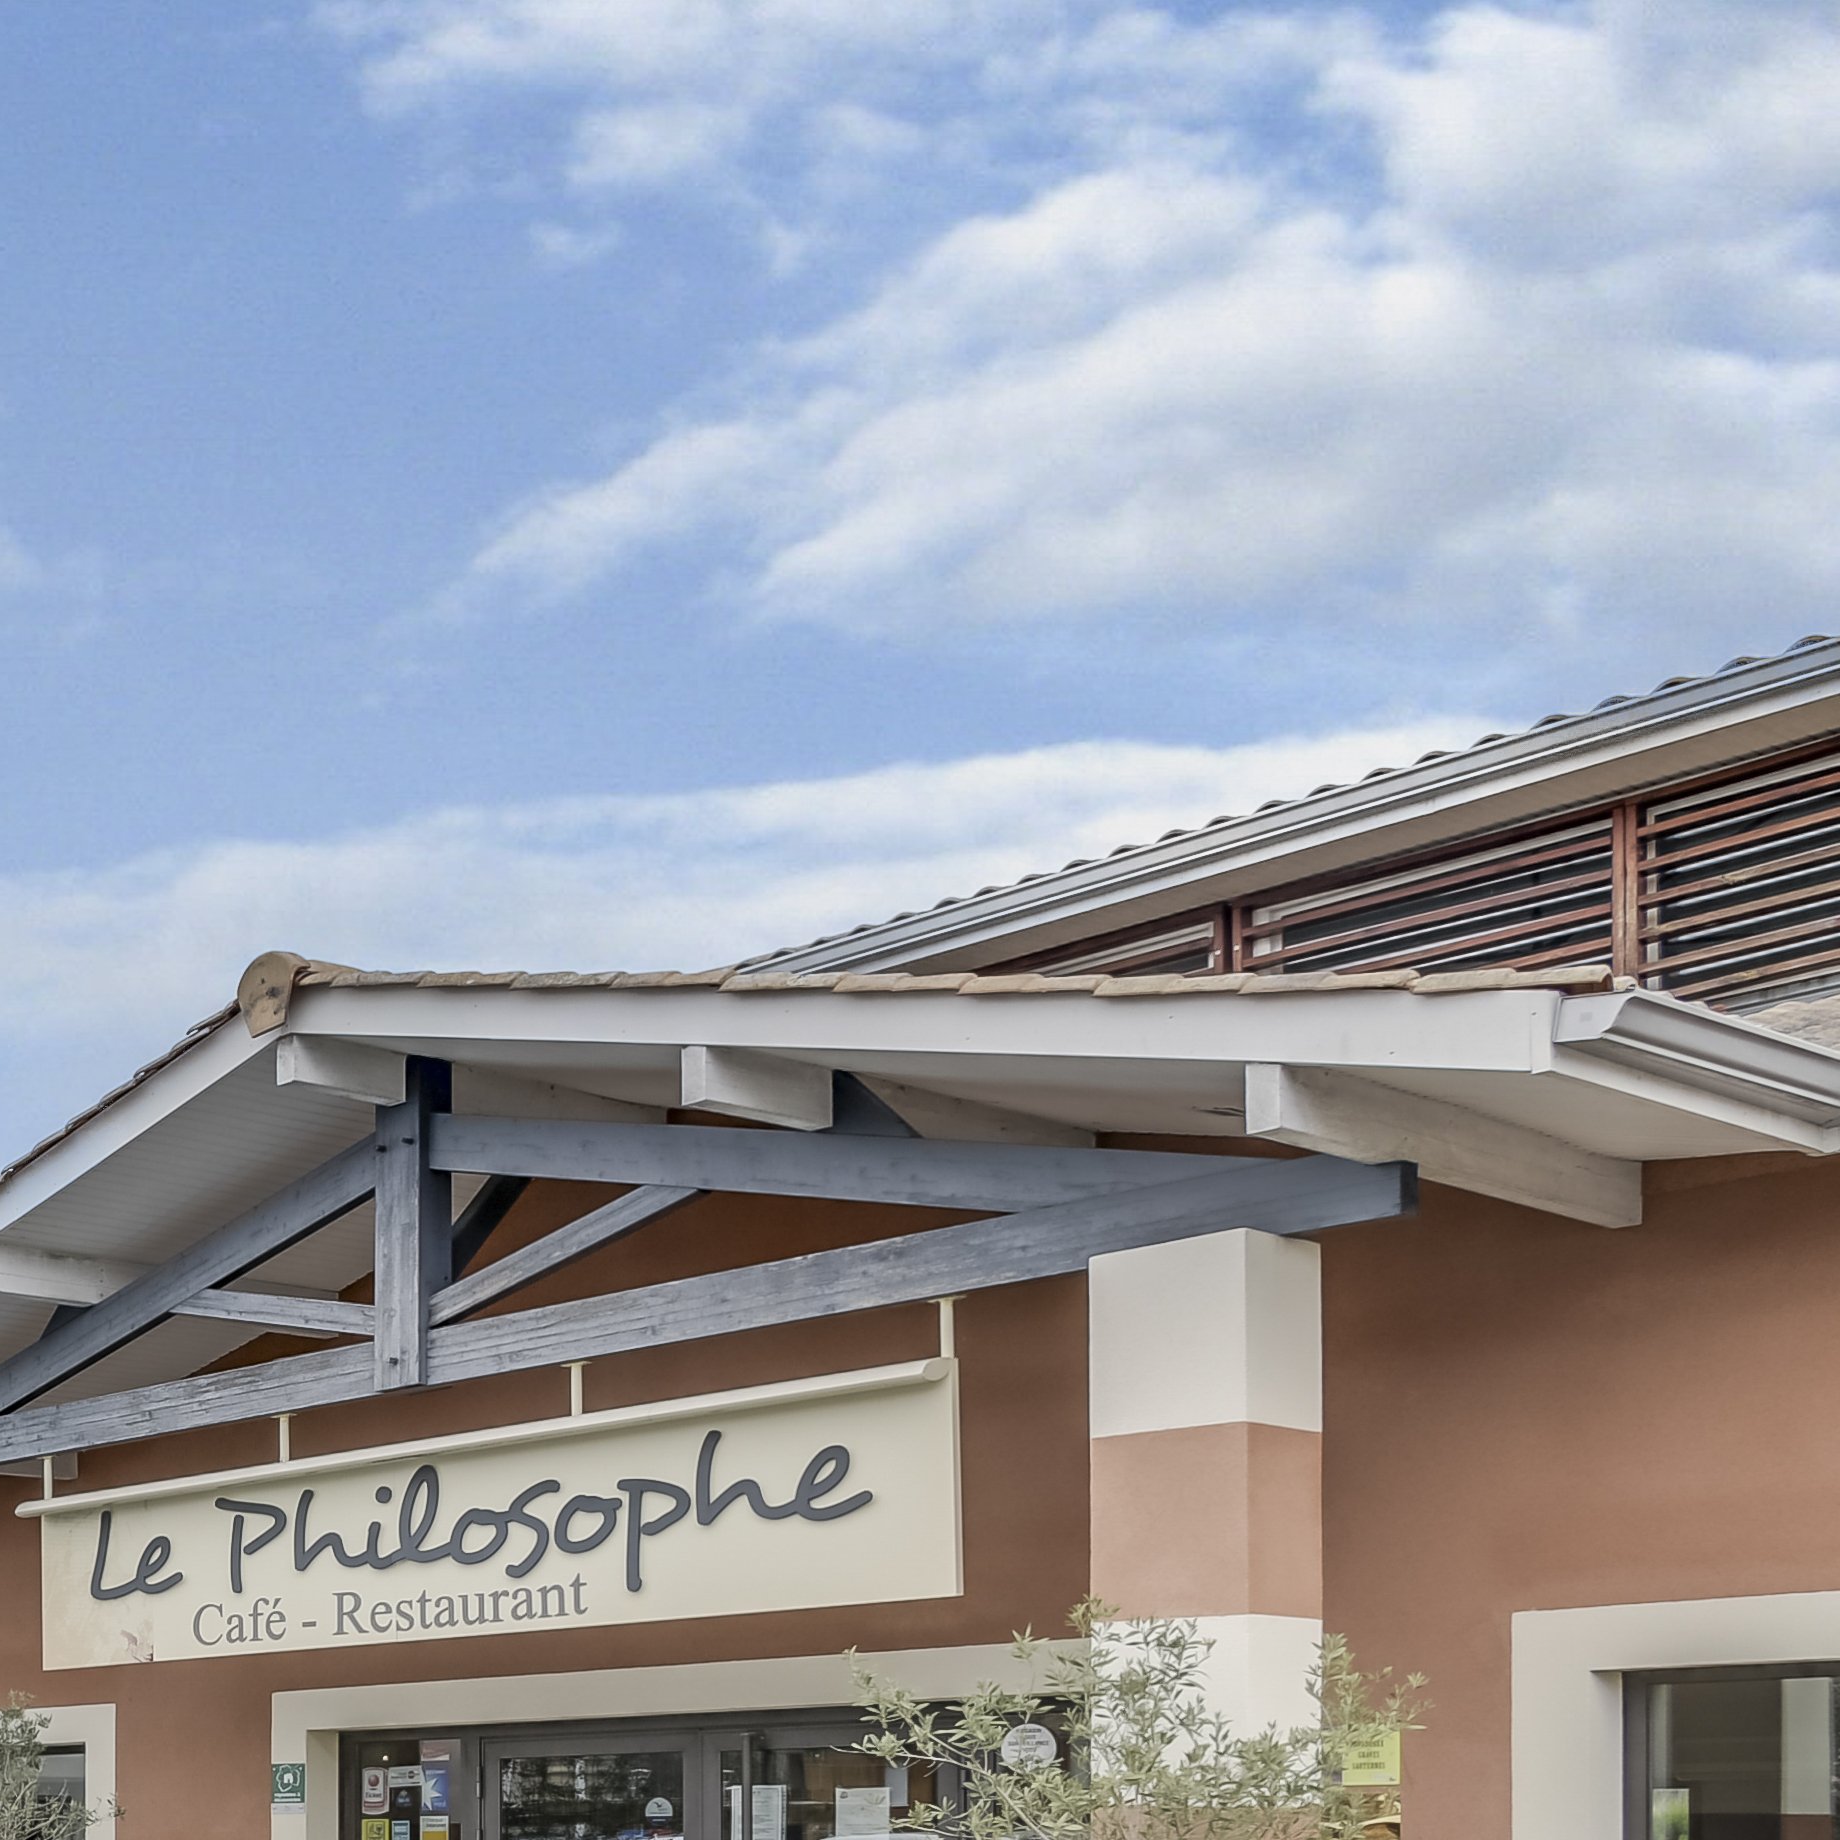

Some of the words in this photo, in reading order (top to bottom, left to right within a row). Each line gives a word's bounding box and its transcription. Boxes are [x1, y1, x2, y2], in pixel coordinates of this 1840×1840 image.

[90, 1509, 184, 1601] Le
[214, 1429, 874, 1594] Philosophe
[192, 1597, 287, 1646] Café
[332, 1572, 589, 1637] Restaurant
